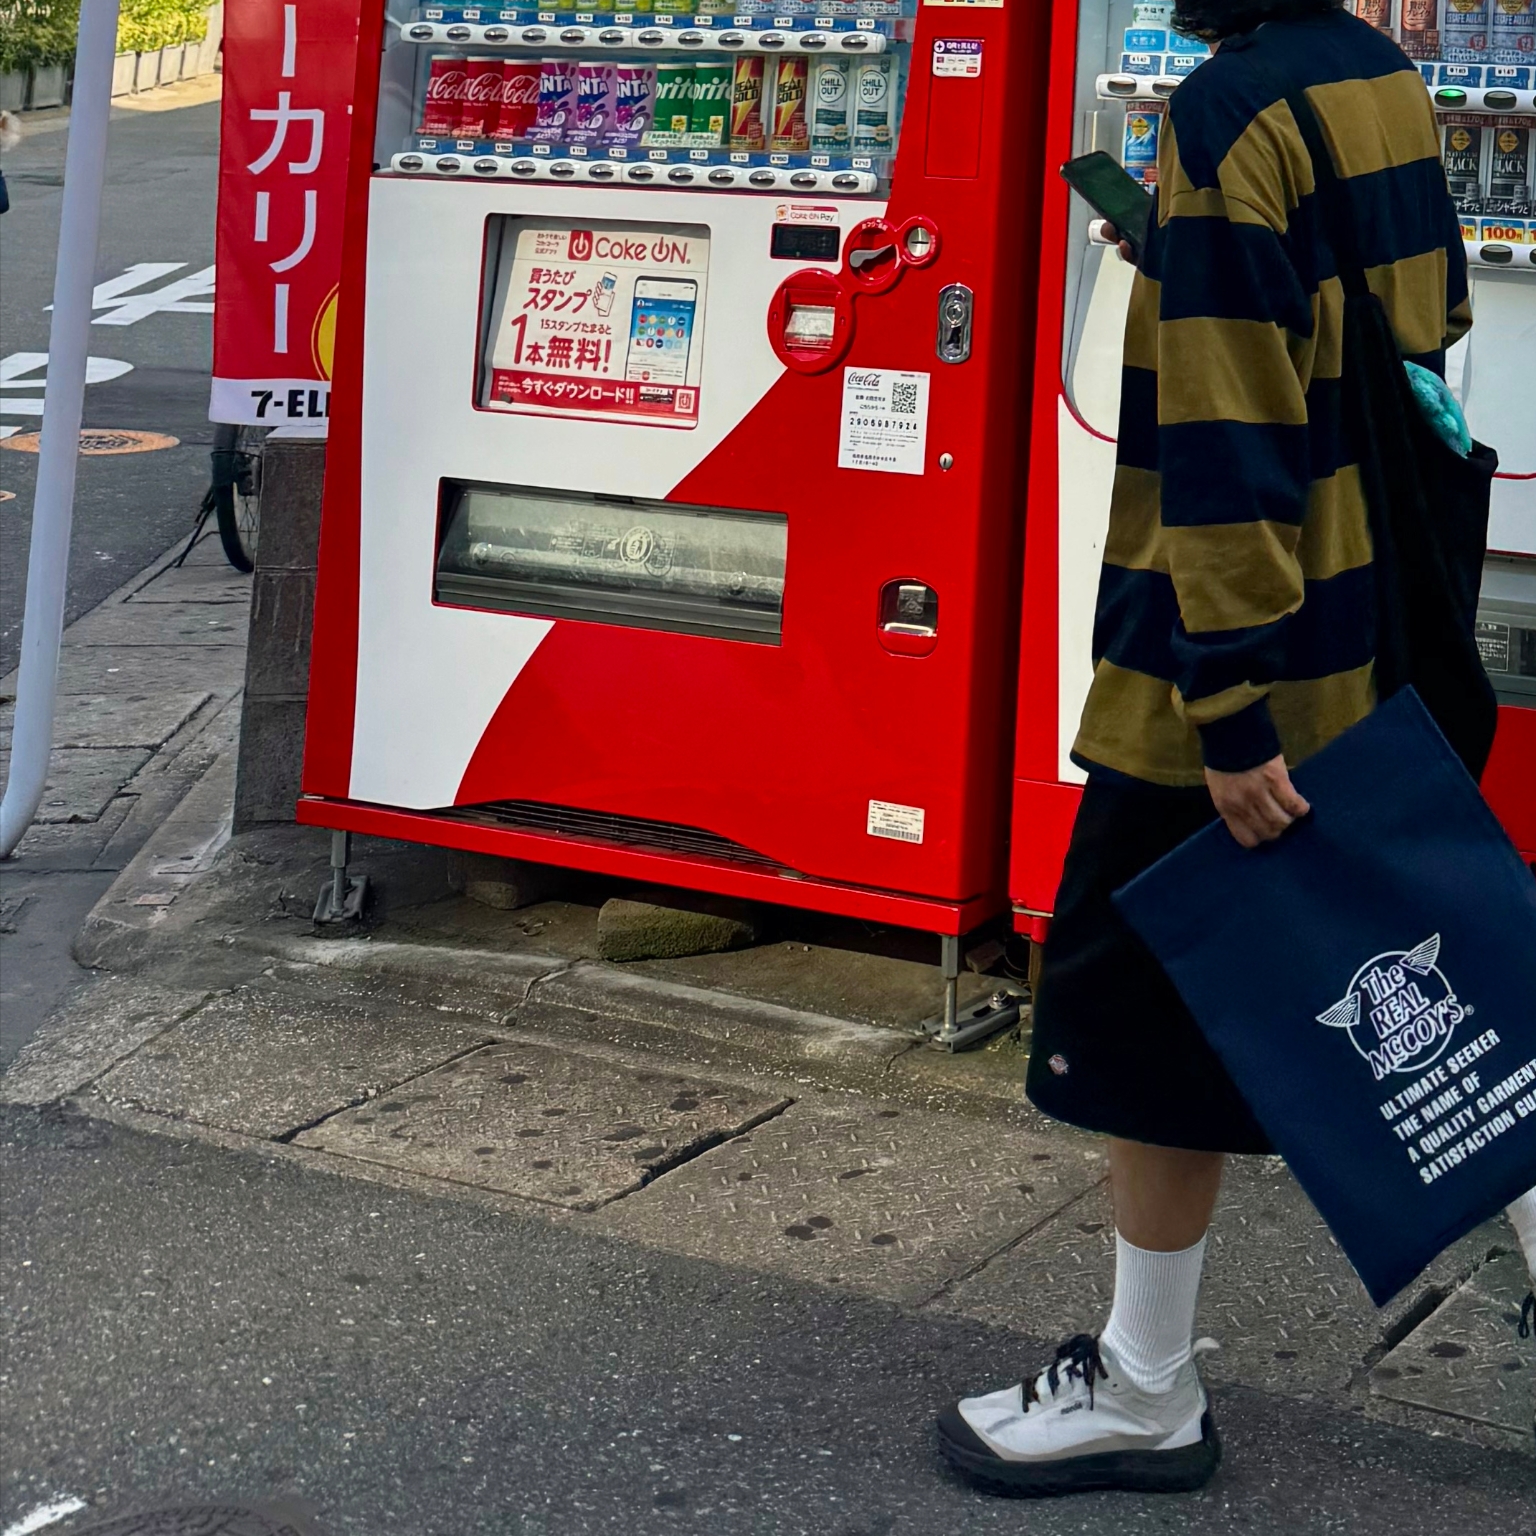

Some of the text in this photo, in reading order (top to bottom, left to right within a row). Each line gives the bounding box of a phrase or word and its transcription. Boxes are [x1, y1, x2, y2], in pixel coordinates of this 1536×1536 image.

[821, 78, 842, 86] CHILL
[821, 86, 839, 95] OUT
[862, 78, 883, 87] CHILL
[862, 88, 880, 96] OUT
[1445, 157, 1477, 171] BLACK
[1493, 159, 1525, 173] BLACK
[1485, 227, 1522, 240] 100円
[595, 237, 648, 261] Coke
[529, 267, 577, 287] 買うたび
[523, 288, 592, 314] スタンプ
[540, 318, 612, 336] 15スタンプたまると
[511, 313, 612, 373] 1本無料!
[521, 377, 635, 405] 今すぐダウンロード!!
[1360, 963, 1405, 1005] The
[1369, 982, 1430, 1040] REAL
[1380, 1028, 1500, 1121] ULTIMATE SEEKER
[1392, 1071, 1482, 1142] THE NAME OF
[1407, 1146, 1421, 1164] A
[1419, 1103, 1476, 1155] QUALITY
[1418, 1110, 1516, 1185] SATISFACTION
